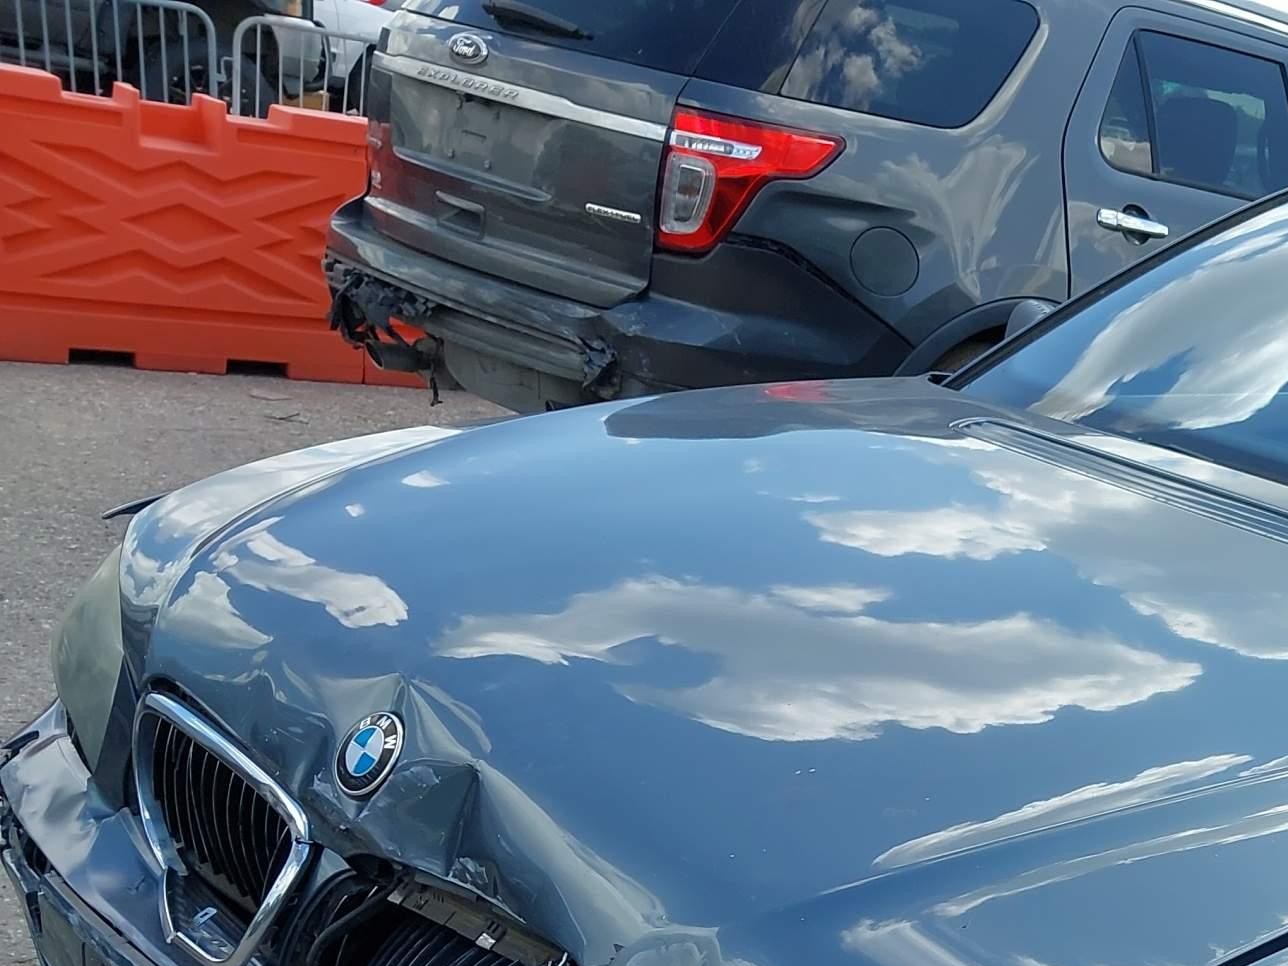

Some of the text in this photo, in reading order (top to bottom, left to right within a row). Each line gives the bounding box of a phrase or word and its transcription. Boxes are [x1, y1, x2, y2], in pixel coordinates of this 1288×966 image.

[452, 37, 477, 57] Ford
[416, 65, 520, 100] EXPLORER
[359, 715, 398, 749] BMW
